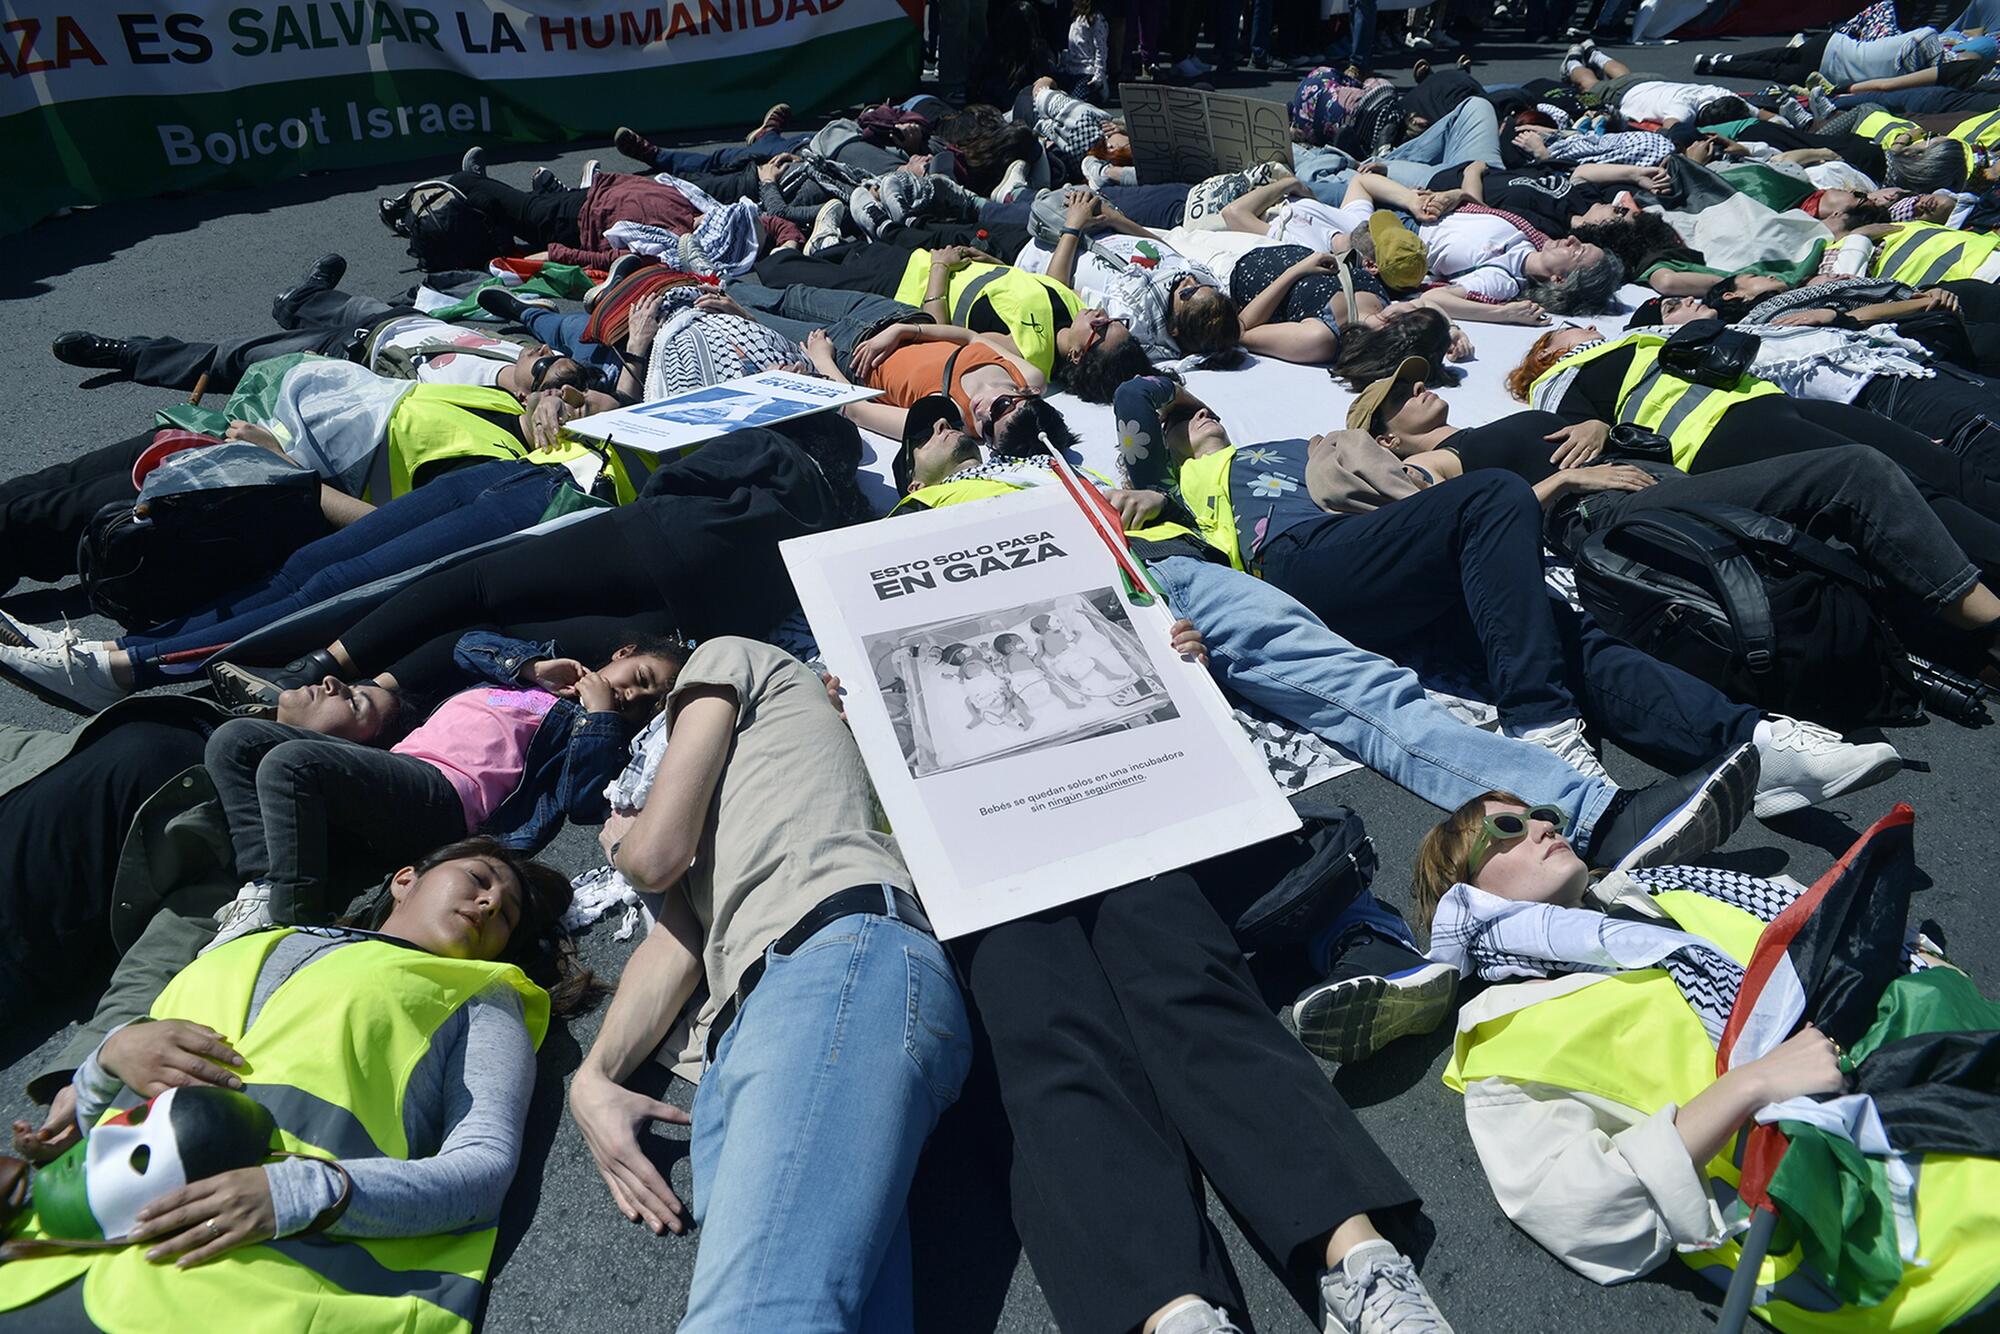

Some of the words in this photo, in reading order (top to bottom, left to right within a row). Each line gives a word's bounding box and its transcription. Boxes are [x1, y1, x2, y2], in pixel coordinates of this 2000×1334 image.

[117, 13, 214, 65] ES
[228, 0, 446, 57] SALVAR
[455, 11, 527, 54] LA
[156, 107, 330, 166] Boicot
[346, 96, 492, 142] Israel
[869, 560, 930, 581] ESTO
[932, 545, 994, 566] SOLO
[996, 531, 1055, 551] PASA
[873, 571, 937, 601] EN
[942, 542, 1069, 583] GAZA
[978, 800, 1012, 817] Bebés
[1013, 796, 1026, 806] se
[1027, 784, 1066, 804] quedan
[1067, 776, 1094, 791] solos
[1095, 772, 1109, 783] en
[1109, 766, 1129, 779] una
[1129, 750, 1185, 772] incubadora
[1030, 801, 1046, 813] sin
[1048, 790, 1083, 808] ningún
[1084, 773, 1148, 797] seguimiento.
